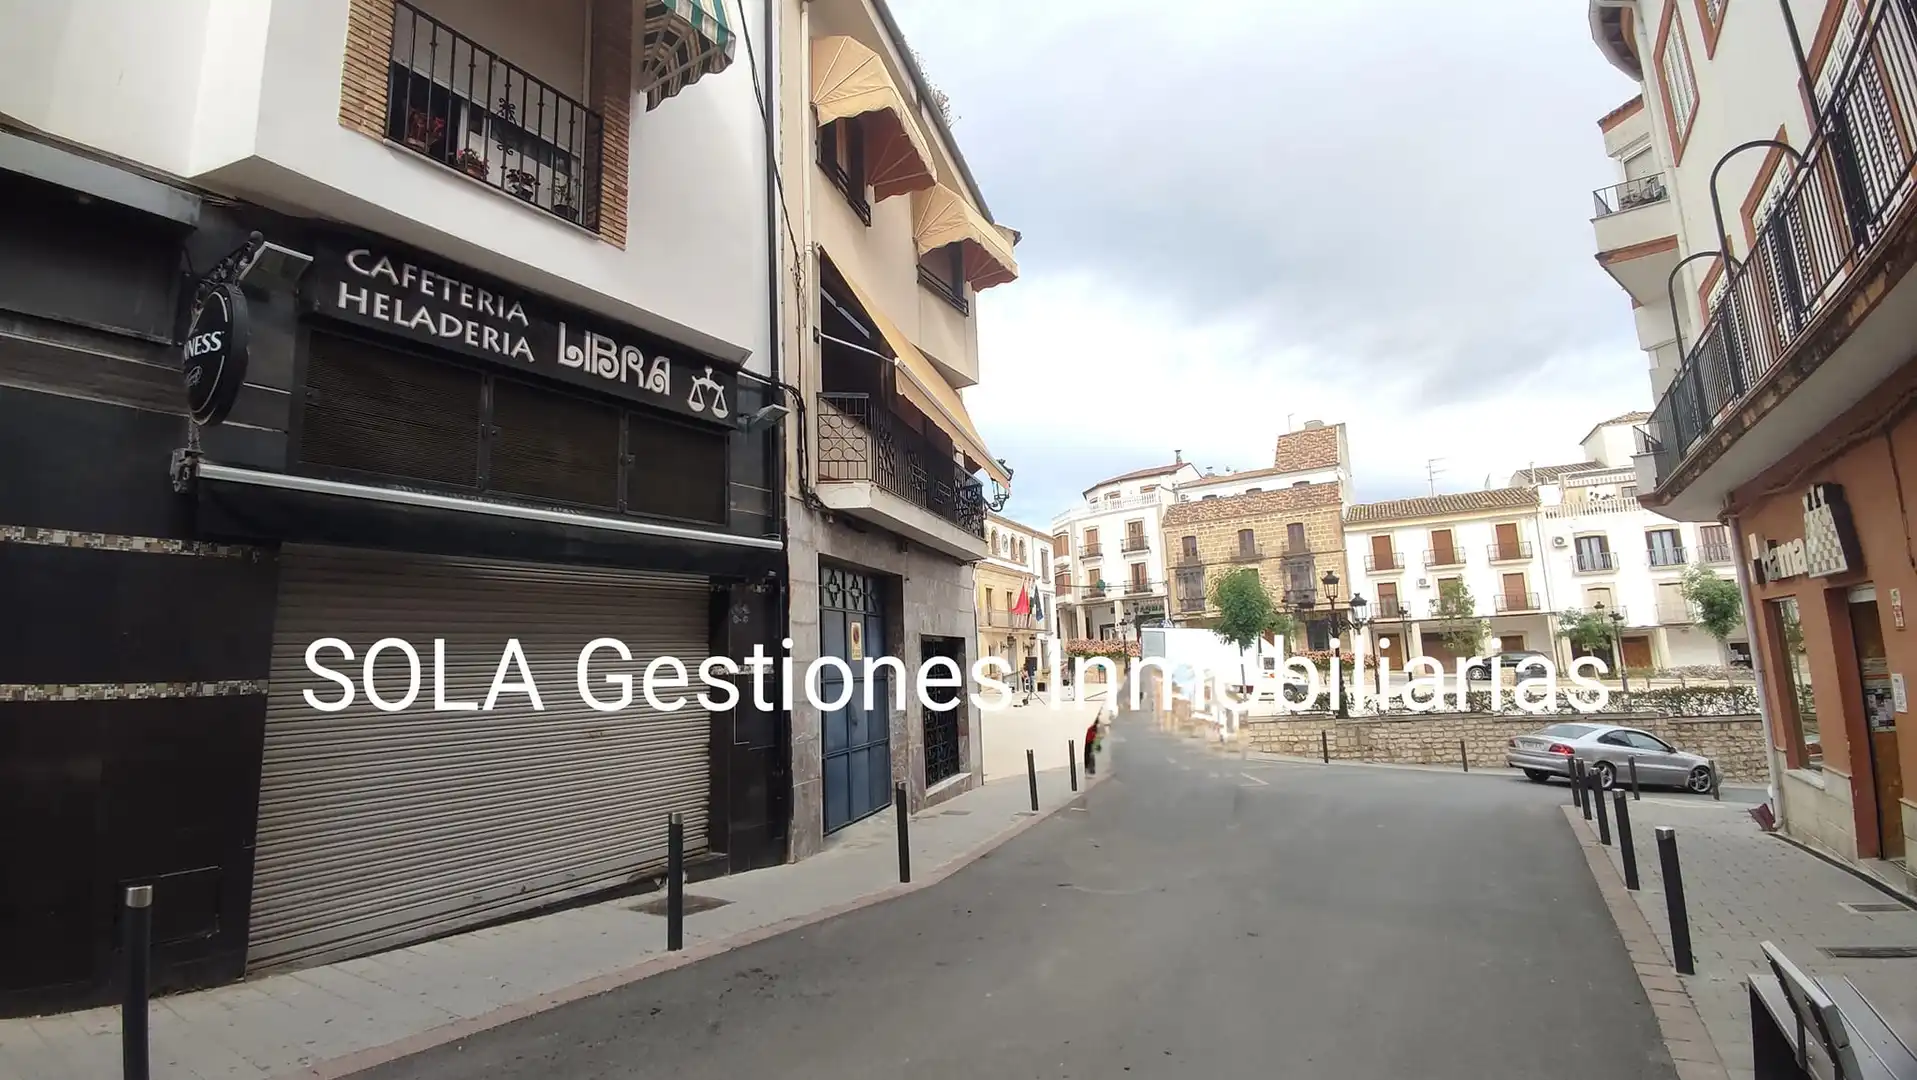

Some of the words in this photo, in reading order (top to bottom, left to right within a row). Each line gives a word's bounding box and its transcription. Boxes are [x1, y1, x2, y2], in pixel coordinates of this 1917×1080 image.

[337, 282, 536, 363] HELADERIA
[345, 248, 530, 327] CAFETERIA
[557, 321, 672, 396] LIBRA
